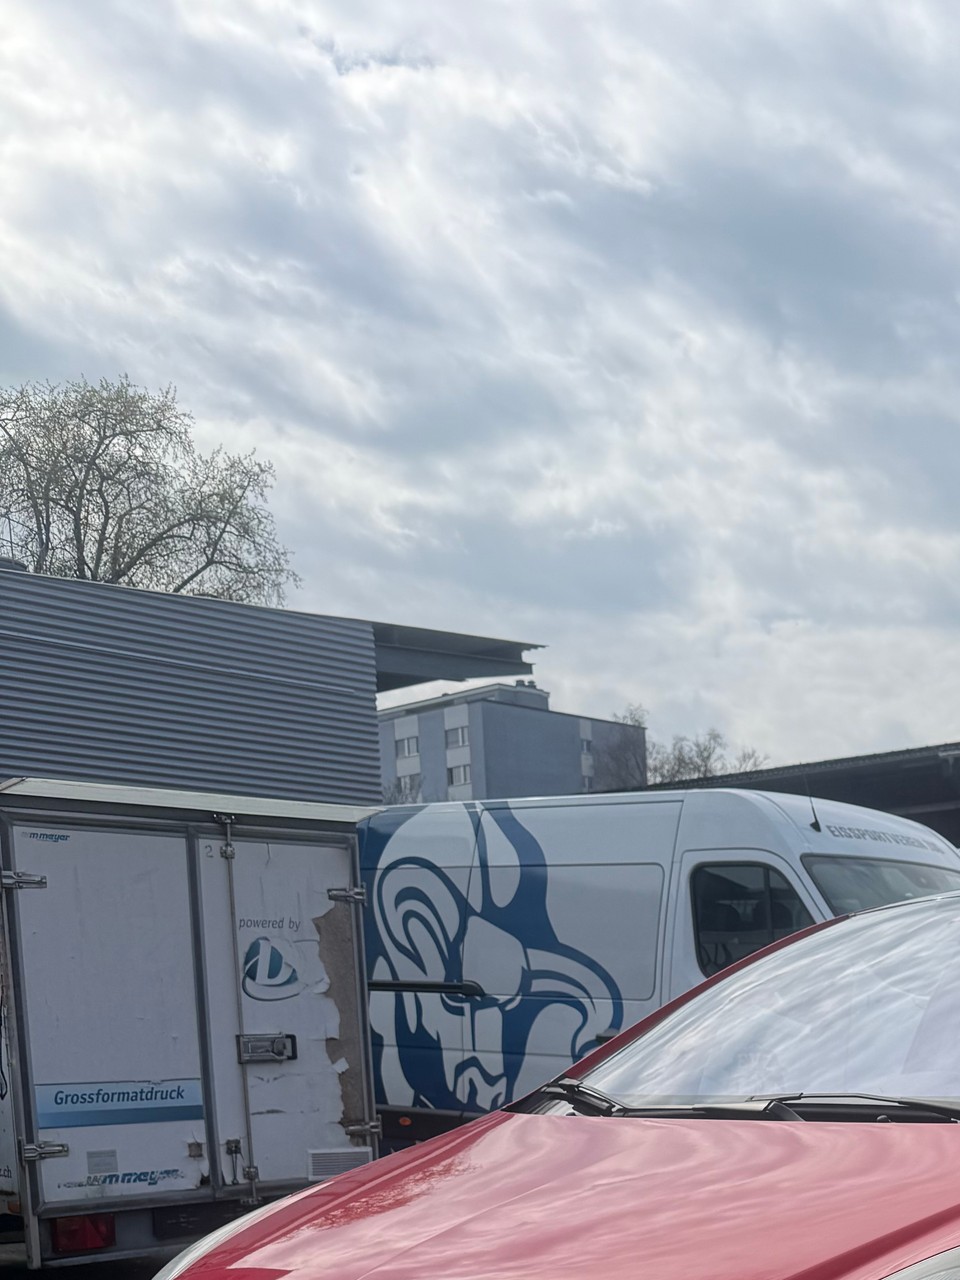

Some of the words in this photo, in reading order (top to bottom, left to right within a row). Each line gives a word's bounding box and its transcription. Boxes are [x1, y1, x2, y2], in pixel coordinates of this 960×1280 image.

[239, 917, 285, 930] powered
[288, 917, 301, 932] by
[54, 1085, 185, 1105] Grossformatdruck
